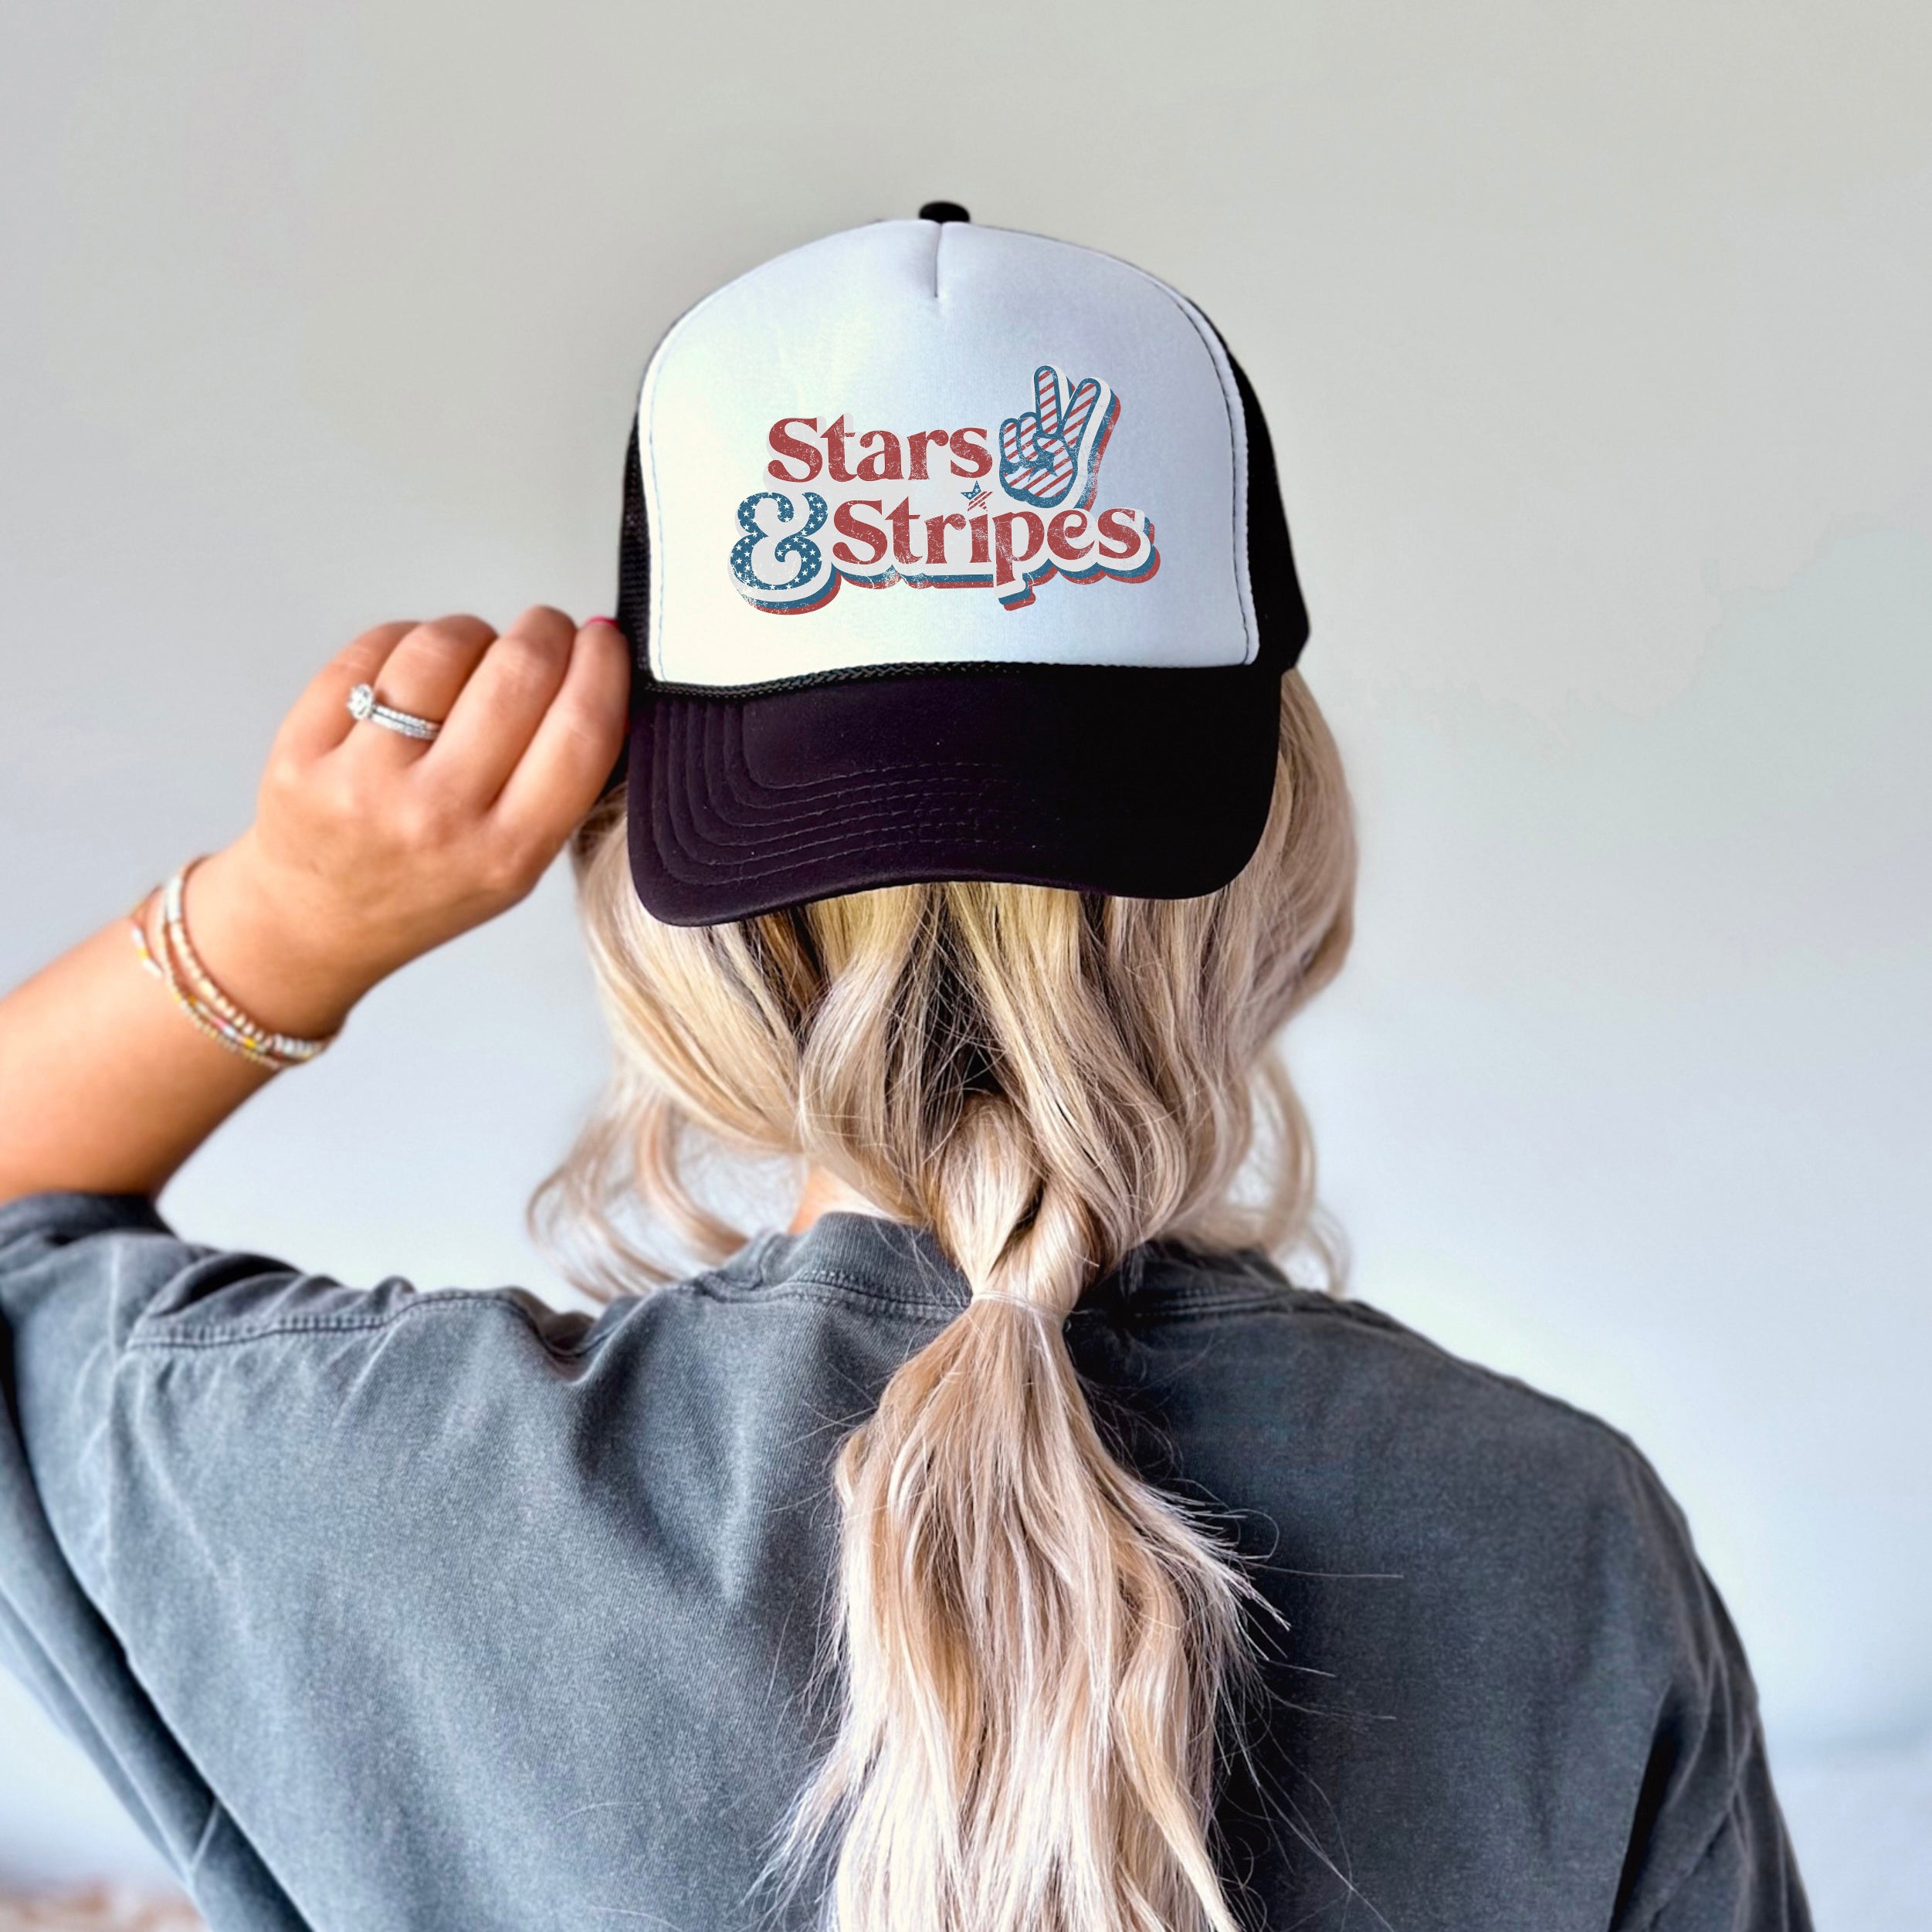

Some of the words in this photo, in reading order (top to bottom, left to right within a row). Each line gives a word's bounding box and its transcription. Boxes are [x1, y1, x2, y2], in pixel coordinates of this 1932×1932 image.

[768, 414, 993, 483] Stars
[730, 492, 829, 590] &
[832, 480, 1141, 586] Stripes
